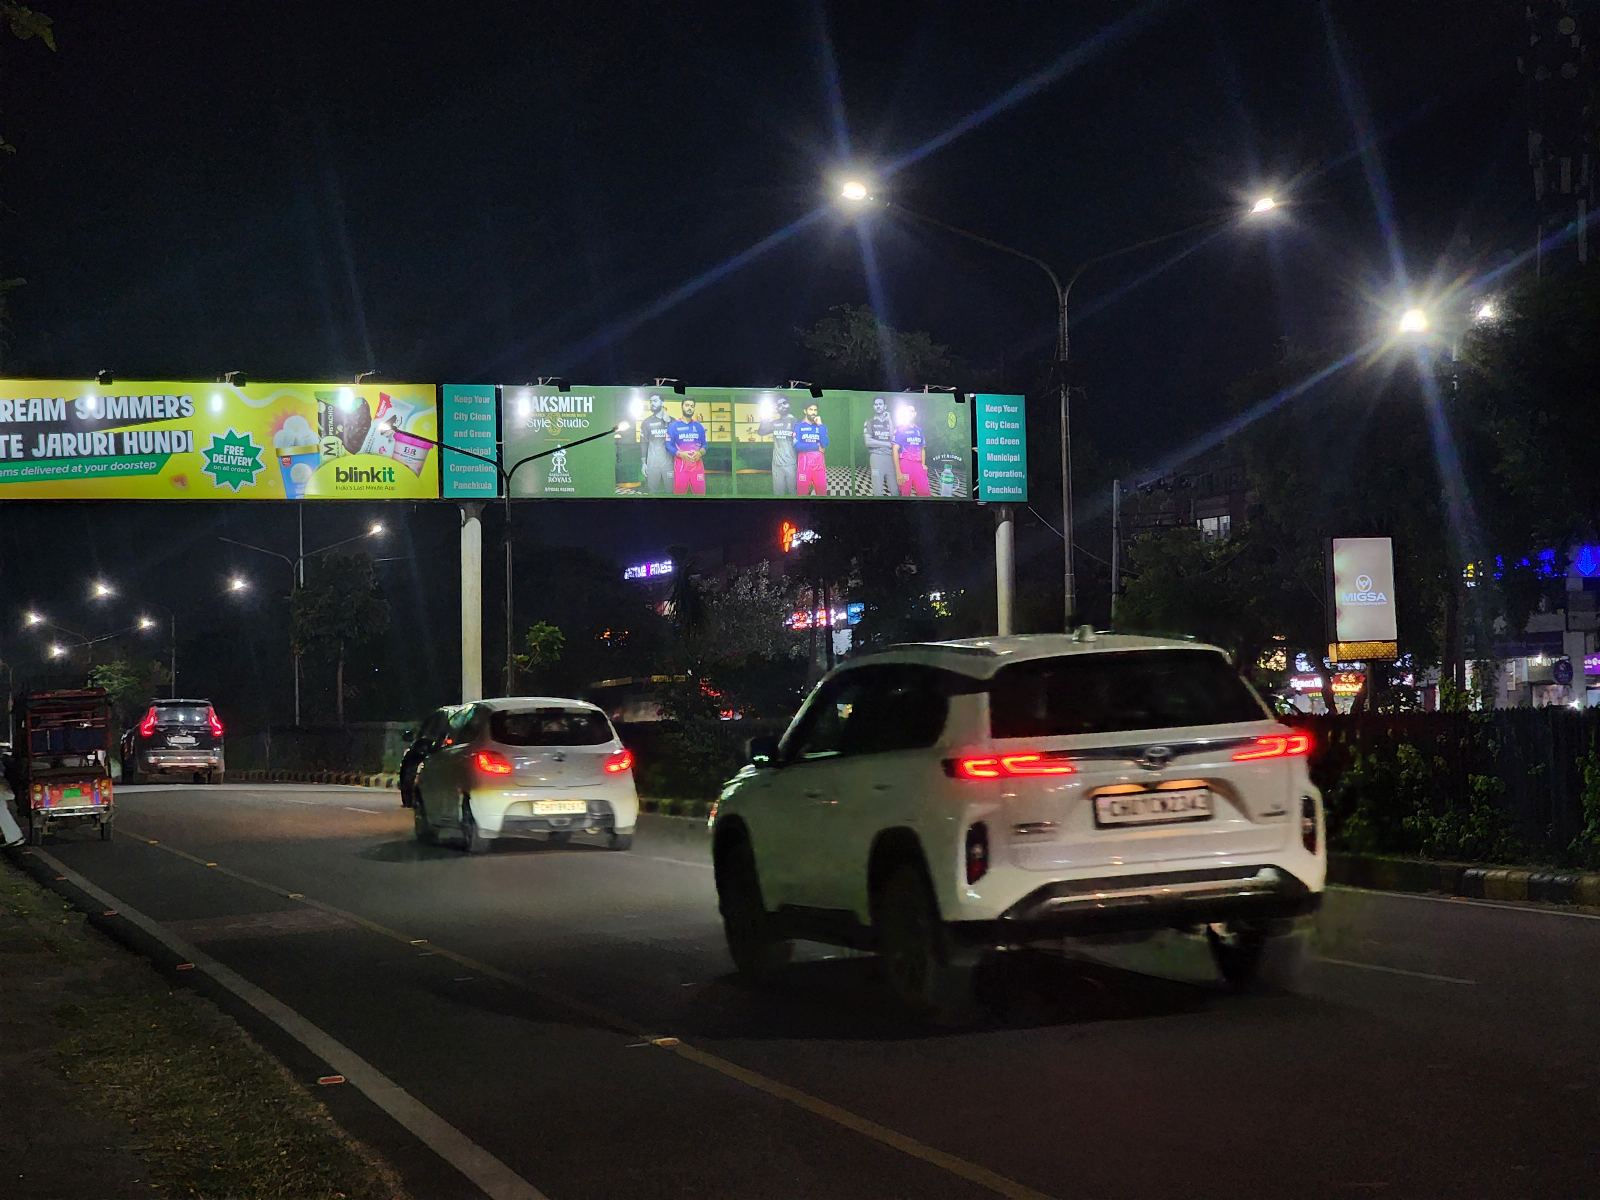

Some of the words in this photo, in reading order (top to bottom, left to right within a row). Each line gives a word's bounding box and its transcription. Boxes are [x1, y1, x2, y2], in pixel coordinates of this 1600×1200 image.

[454, 395, 473, 404] Keep
[474, 395, 491, 404] Your
[521, 396, 593, 412] AKSMITH
[75, 396, 195, 419] SUMMERS
[985, 404, 1002, 413] Keep
[1002, 405, 1018, 413] Your
[454, 412, 468, 422] City
[470, 412, 492, 421] Clean
[527, 418, 551, 433] Style
[557, 418, 590, 428] Studio
[985, 421, 999, 430] City
[1000, 421, 1020, 429] Clean
[454, 430, 468, 438] and
[469, 430, 492, 438] Green
[31, 432, 116, 458] JARURI
[122, 430, 193, 455] HUNDI
[985, 437, 999, 445] and
[1000, 437, 1020, 445] Green
[224, 445, 245, 456] FREE
[213, 454, 253, 467] DELIVERY
[986, 453, 1020, 462] Municipal
[20, 465, 70, 476] delivered
[71, 464, 82, 473] at
[84, 463, 109, 474] your
[111, 461, 157, 471] doorstep
[335, 467, 395, 483] blinkit
[453, 481, 493, 490] Panchkula
[987, 485, 1023, 494] Panchkula
[1342, 592, 1387, 602] MIGSA
